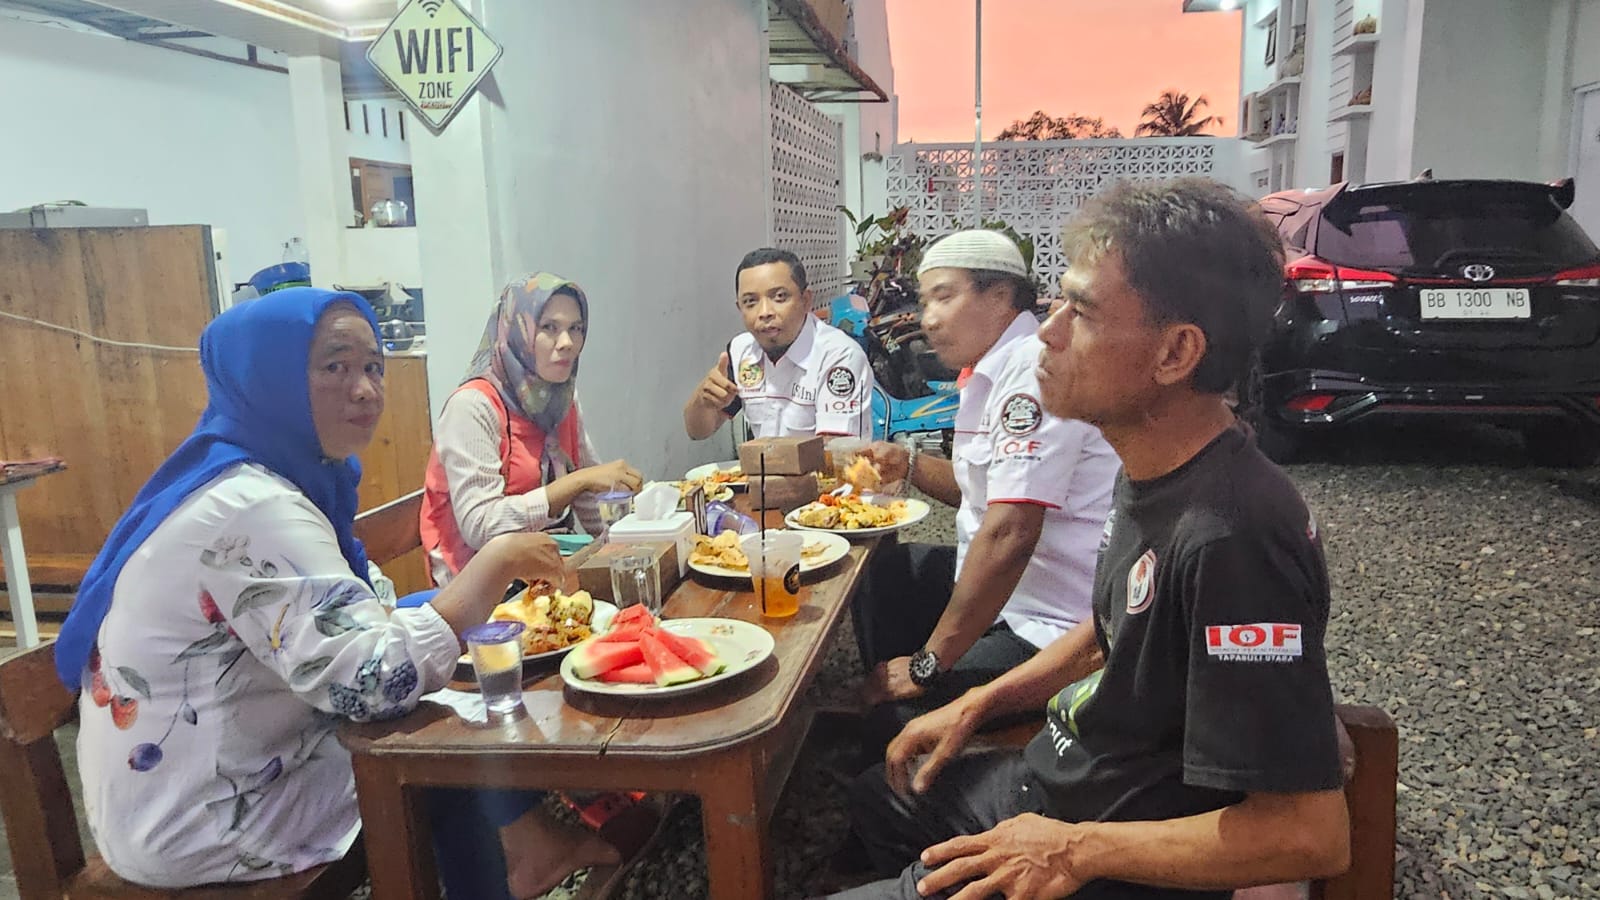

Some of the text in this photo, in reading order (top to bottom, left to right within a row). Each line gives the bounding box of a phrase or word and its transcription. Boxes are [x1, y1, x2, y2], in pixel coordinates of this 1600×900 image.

[393, 27, 474, 75] WIFI
[418, 82, 454, 99] ZONE
[1427, 292, 1525, 307] BB 1300 NB
[1208, 625, 1300, 647] IOF
